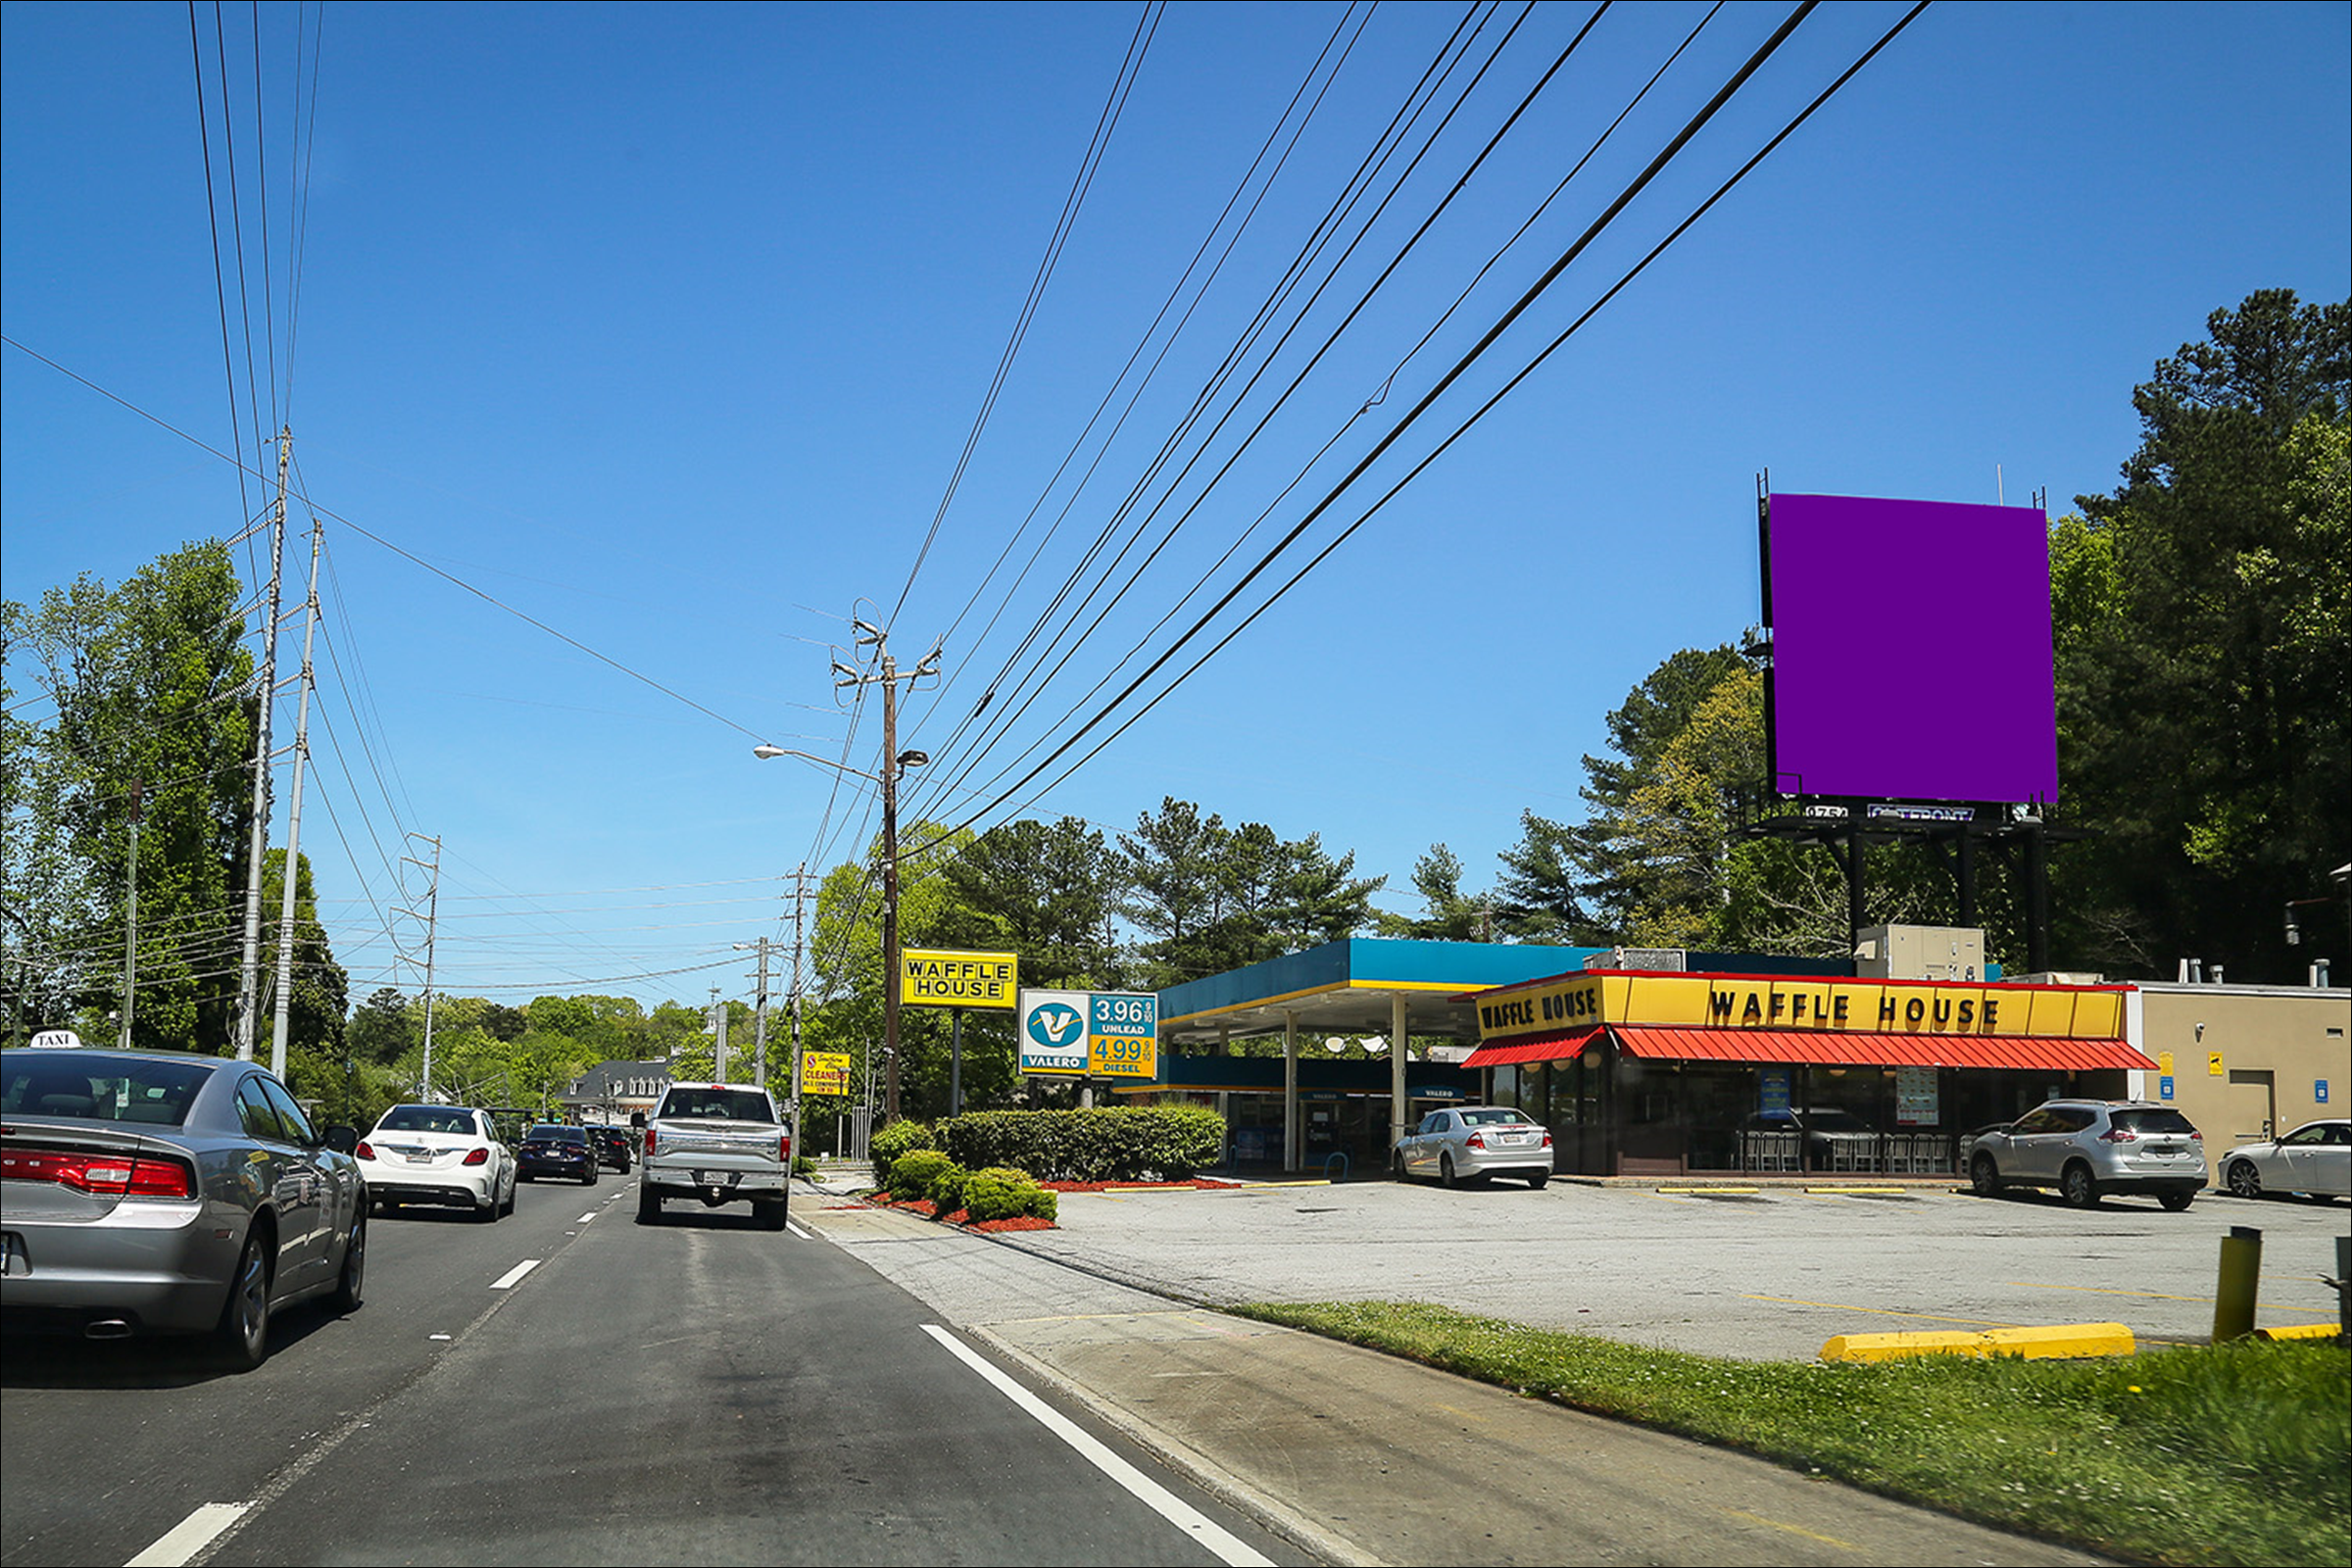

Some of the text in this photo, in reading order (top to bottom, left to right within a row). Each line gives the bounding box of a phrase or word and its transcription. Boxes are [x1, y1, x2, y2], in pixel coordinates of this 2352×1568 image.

[1873, 806, 1968, 821] OTFRONT
[907, 961, 1009, 979] WAFFLE
[917, 980, 1001, 997] HOUSE
[1096, 1000, 1143, 1022] 3.96
[1481, 988, 1597, 1029] WAFFLE HOUSE
[1711, 991, 1999, 1024] WAFFLE HOUSE
[1102, 1024, 1146, 1035] UNLEAD
[37, 1034, 69, 1046] TAXI
[1095, 1039, 1142, 1061] 4.99
[1028, 1055, 1081, 1068] VALERO
[1103, 1062, 1141, 1073] DIESEL
[805, 1069, 848, 1082] CLEANERS
[1425, 1089, 1454, 1098] VALERO
